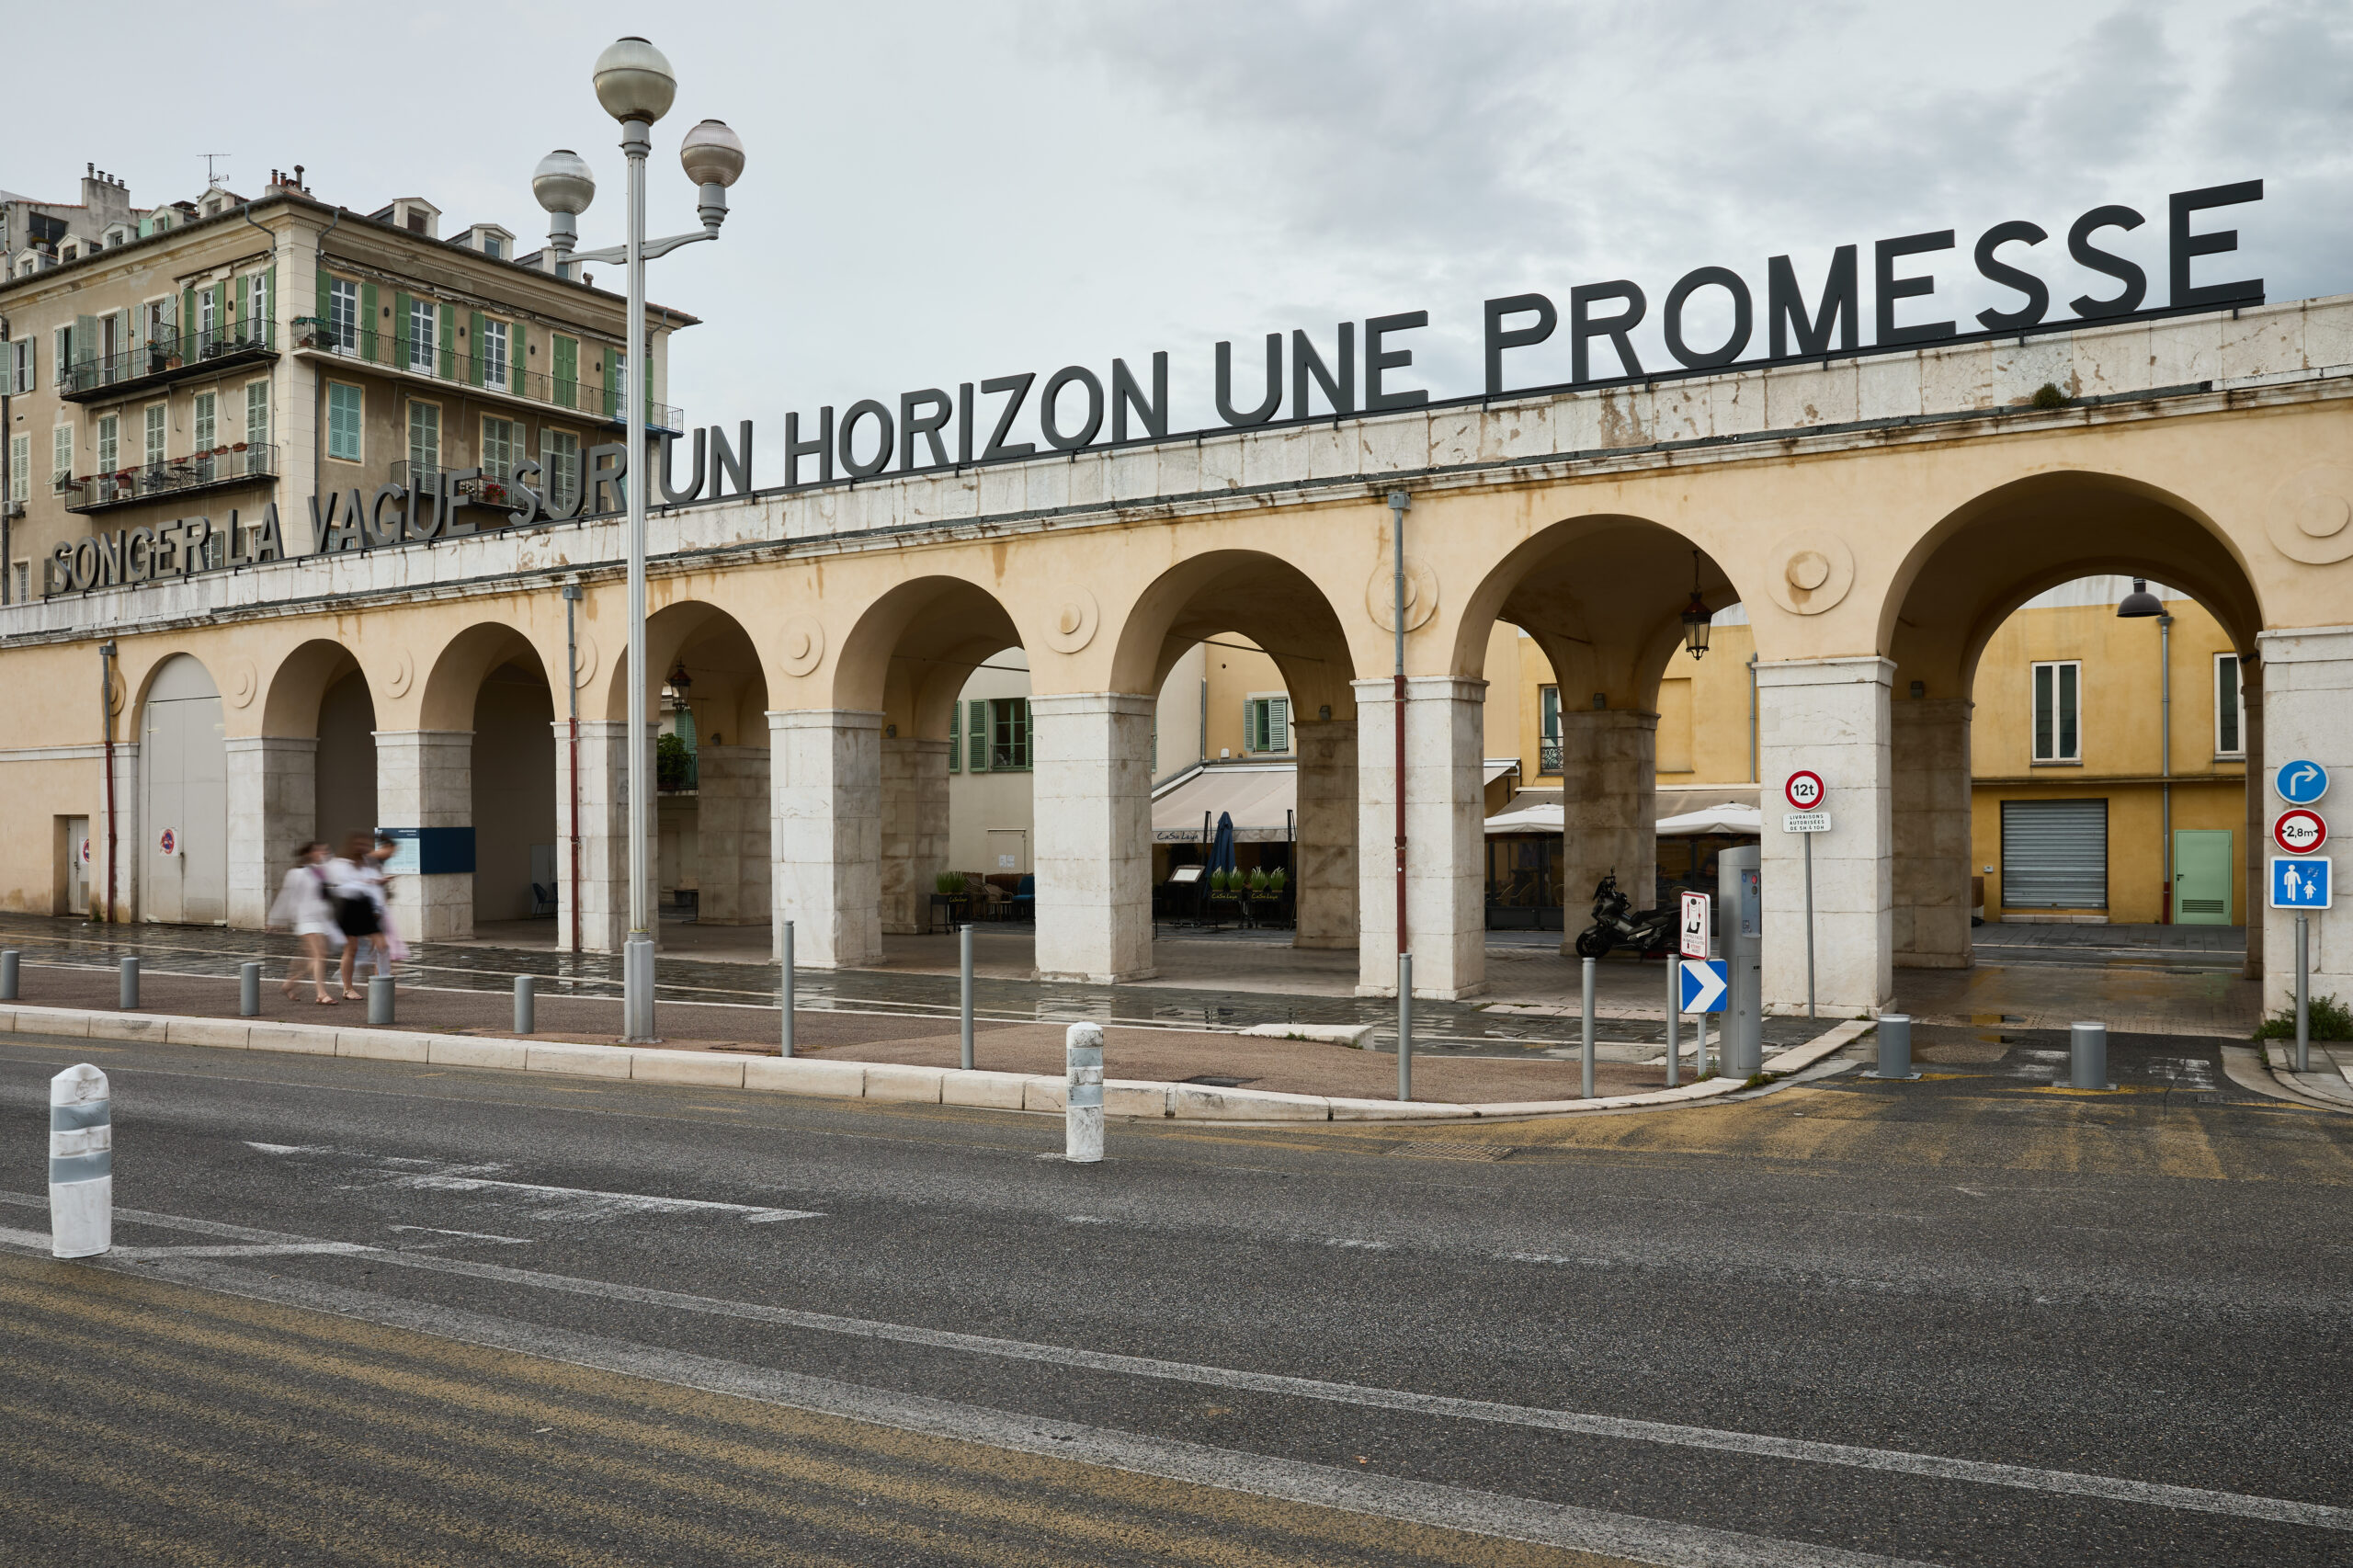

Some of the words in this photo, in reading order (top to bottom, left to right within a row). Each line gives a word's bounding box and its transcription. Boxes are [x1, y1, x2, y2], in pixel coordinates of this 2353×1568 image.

[51, 515, 211, 591] SONGER
[227, 502, 285, 565] LA
[307, 467, 482, 553] VAGUE
[507, 442, 628, 527] SUR
[658, 418, 753, 503] UN
[785, 350, 1168, 485] HORIZON
[1215, 311, 1429, 425] UNE
[1483, 178, 2265, 393] PROMESSE
[1793, 784, 1815, 796] 12t
[2286, 825, 2313, 838] 2,8m
